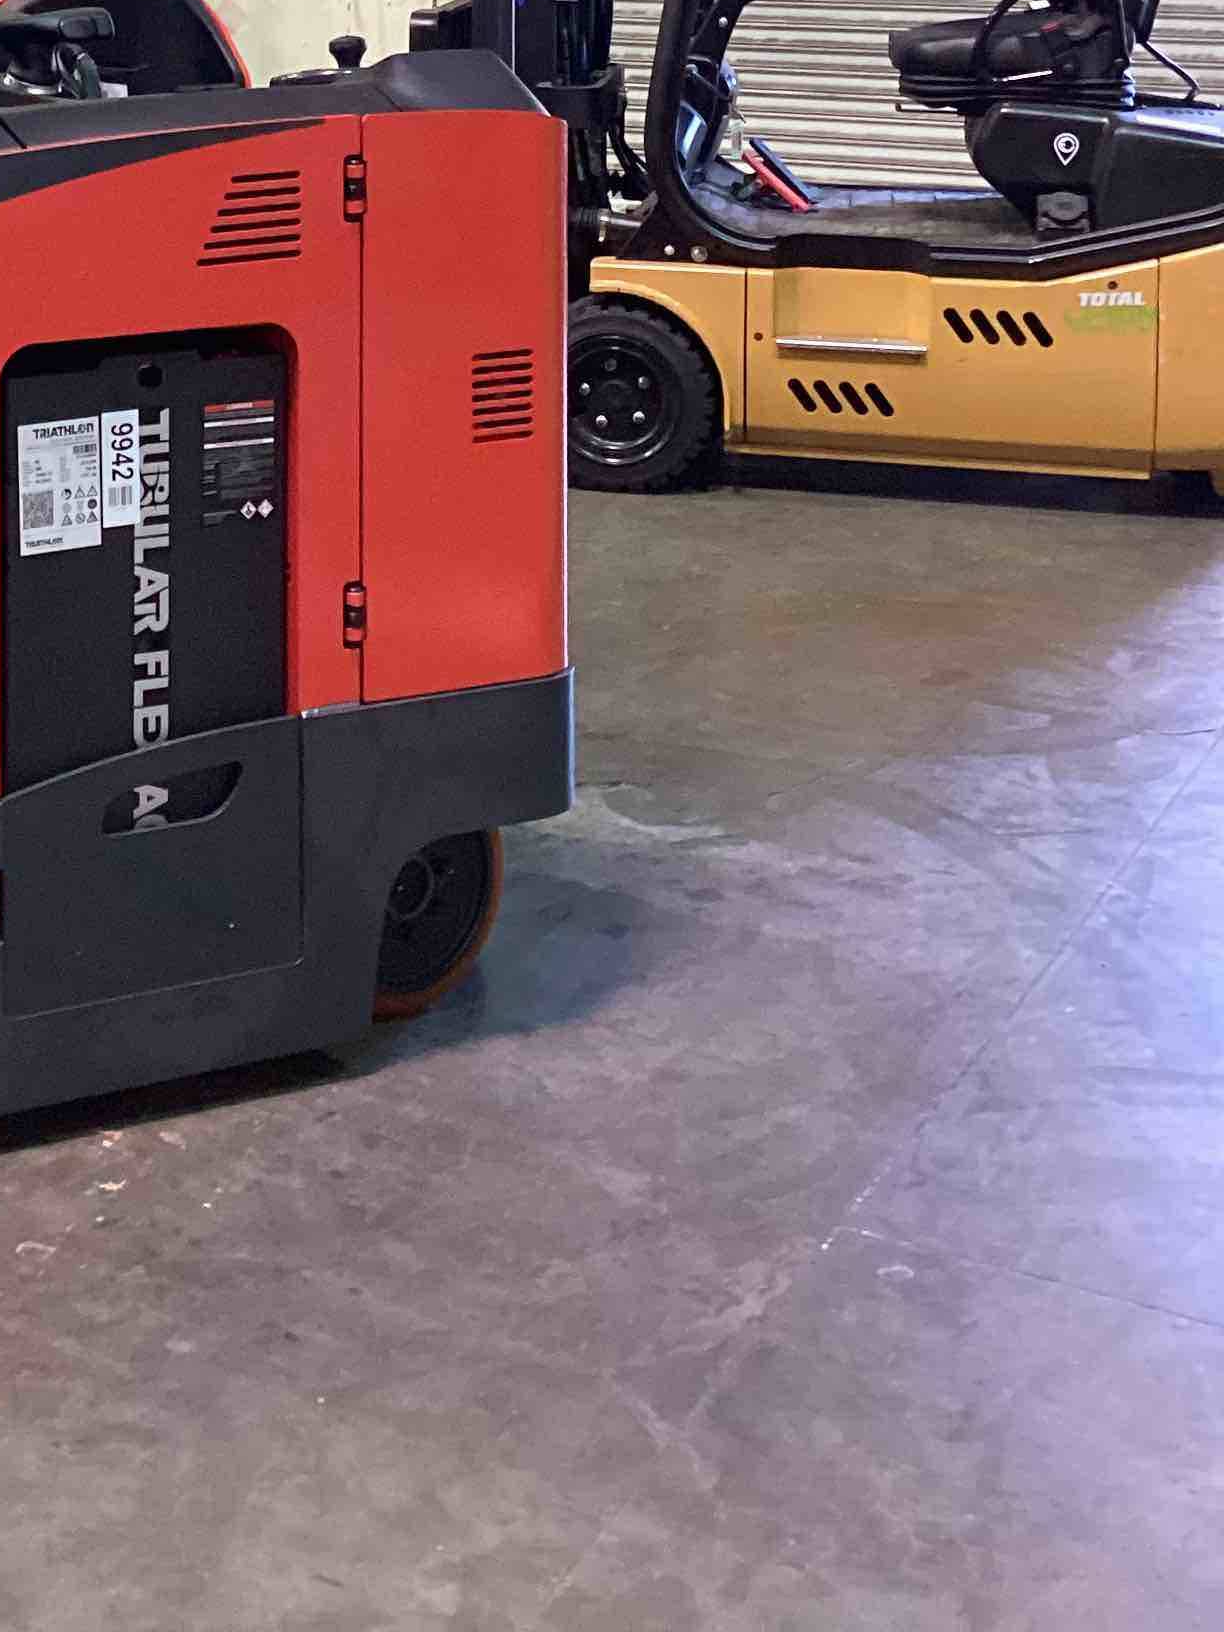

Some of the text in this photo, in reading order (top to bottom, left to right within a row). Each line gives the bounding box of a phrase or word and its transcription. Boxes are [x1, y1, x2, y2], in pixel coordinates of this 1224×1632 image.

[1079, 291, 1145, 307] TOTAL
[110, 422, 135, 482] 9942
[133, 407, 170, 636] TUBULAR
